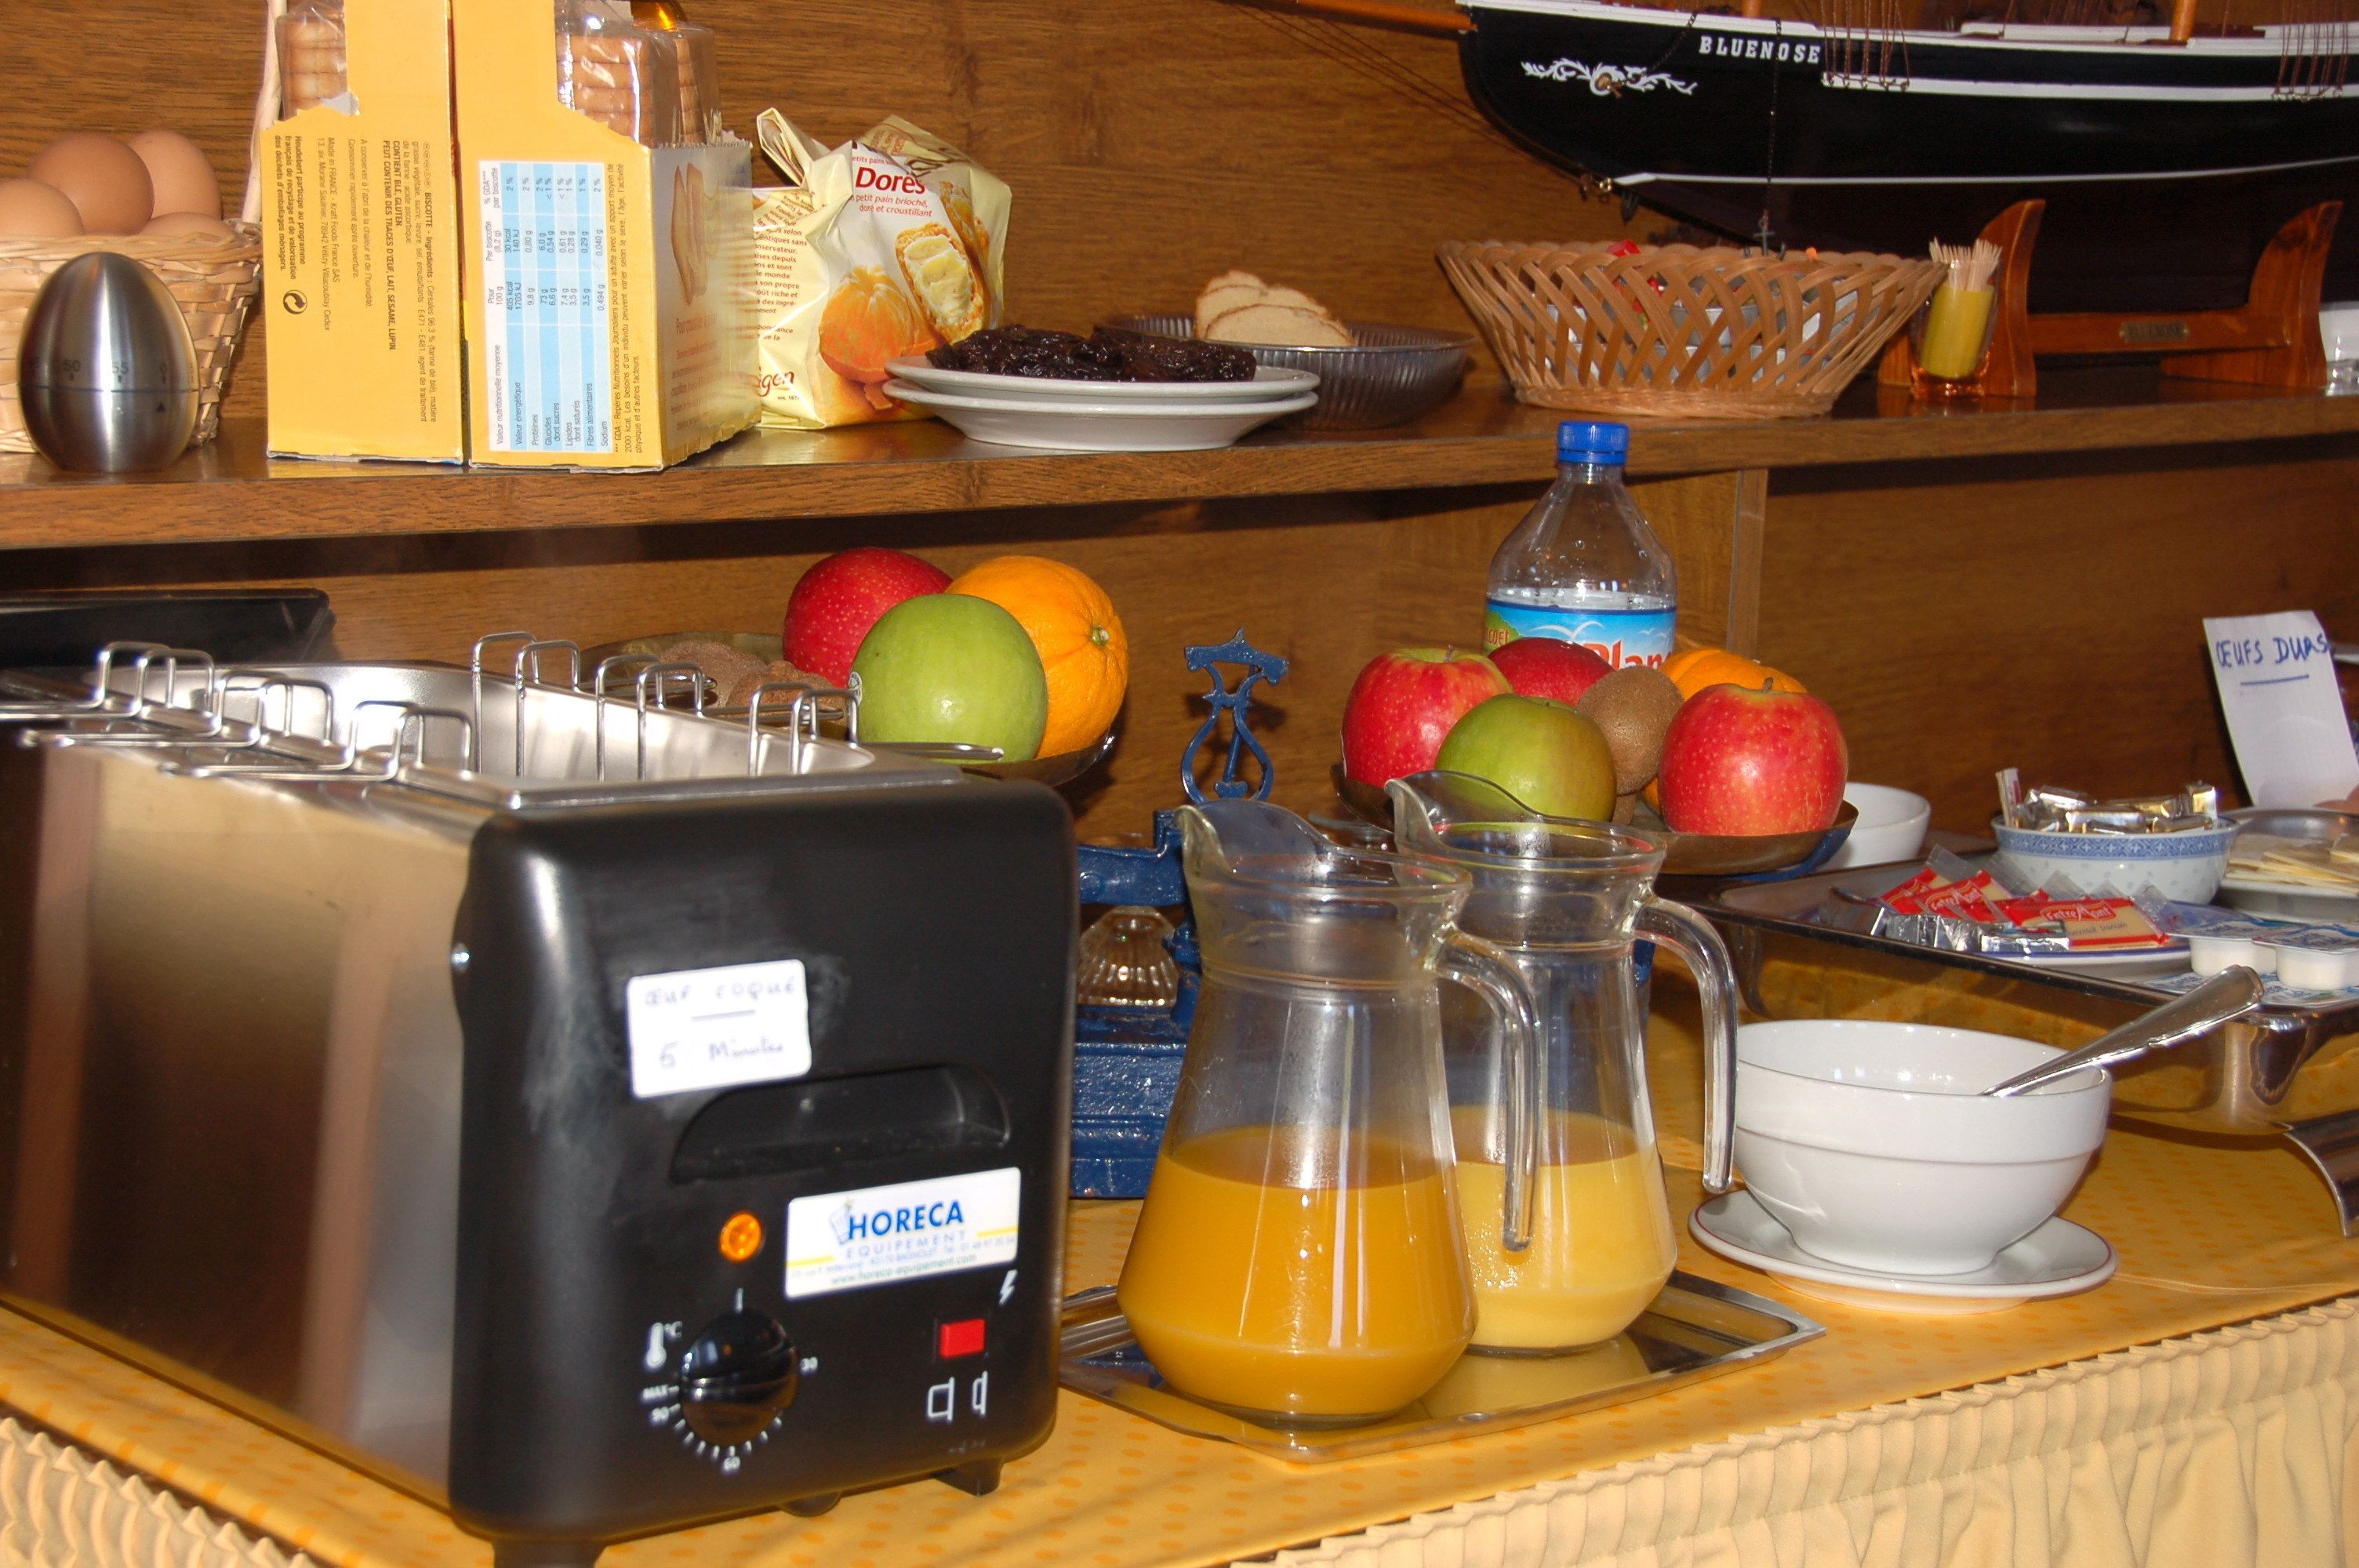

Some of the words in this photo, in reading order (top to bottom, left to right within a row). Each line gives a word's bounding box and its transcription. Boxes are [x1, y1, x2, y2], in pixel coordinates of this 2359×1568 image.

[1699, 35, 1820, 64] BLUENOSE
[275, 151, 284, 180] déchets
[284, 136, 293, 166] français
[295, 136, 304, 174] Heudebert
[393, 140, 402, 176] CONTIENT
[411, 142, 420, 164] grasse
[286, 169, 294, 177] de
[383, 162, 393, 198] CONTENIR
[606, 163, 614, 172] de
[285, 180, 295, 214] recyclage
[296, 176, 305, 209] participe
[607, 174, 616, 198] moyen
[874, 195, 893, 204] pain
[276, 182, 285, 231] d'emballages
[298, 211, 305, 220] au
[349, 183, 358, 221] rapidement
[608, 200, 616, 223] apport
[886, 207, 932, 217] croustillant
[289, 227, 296, 235] de
[297, 222, 307, 265] programme
[350, 223, 358, 242] après
[289, 238, 298, 280] valorisation
[505, 245, 511, 253] 30
[618, 249, 627, 267] selon
[610, 290, 619, 305] pour
[775, 281, 800, 289] propre
[540, 296, 547, 304] 73
[323, 310, 332, 331] Cedex
[620, 324, 629, 350] individu
[112, 361, 129, 374] 55
[494, 345, 503, 376] moyenne
[612, 347, 620, 390] Nutritionnels
[514, 383, 522, 422] énergétique
[633, 423, 642, 453] physique
[2215, 638, 2264, 668] ŒUFS
[847, 1200, 965, 1241] HORECA
[845, 1229, 966, 1260] EQUIPEMENT
